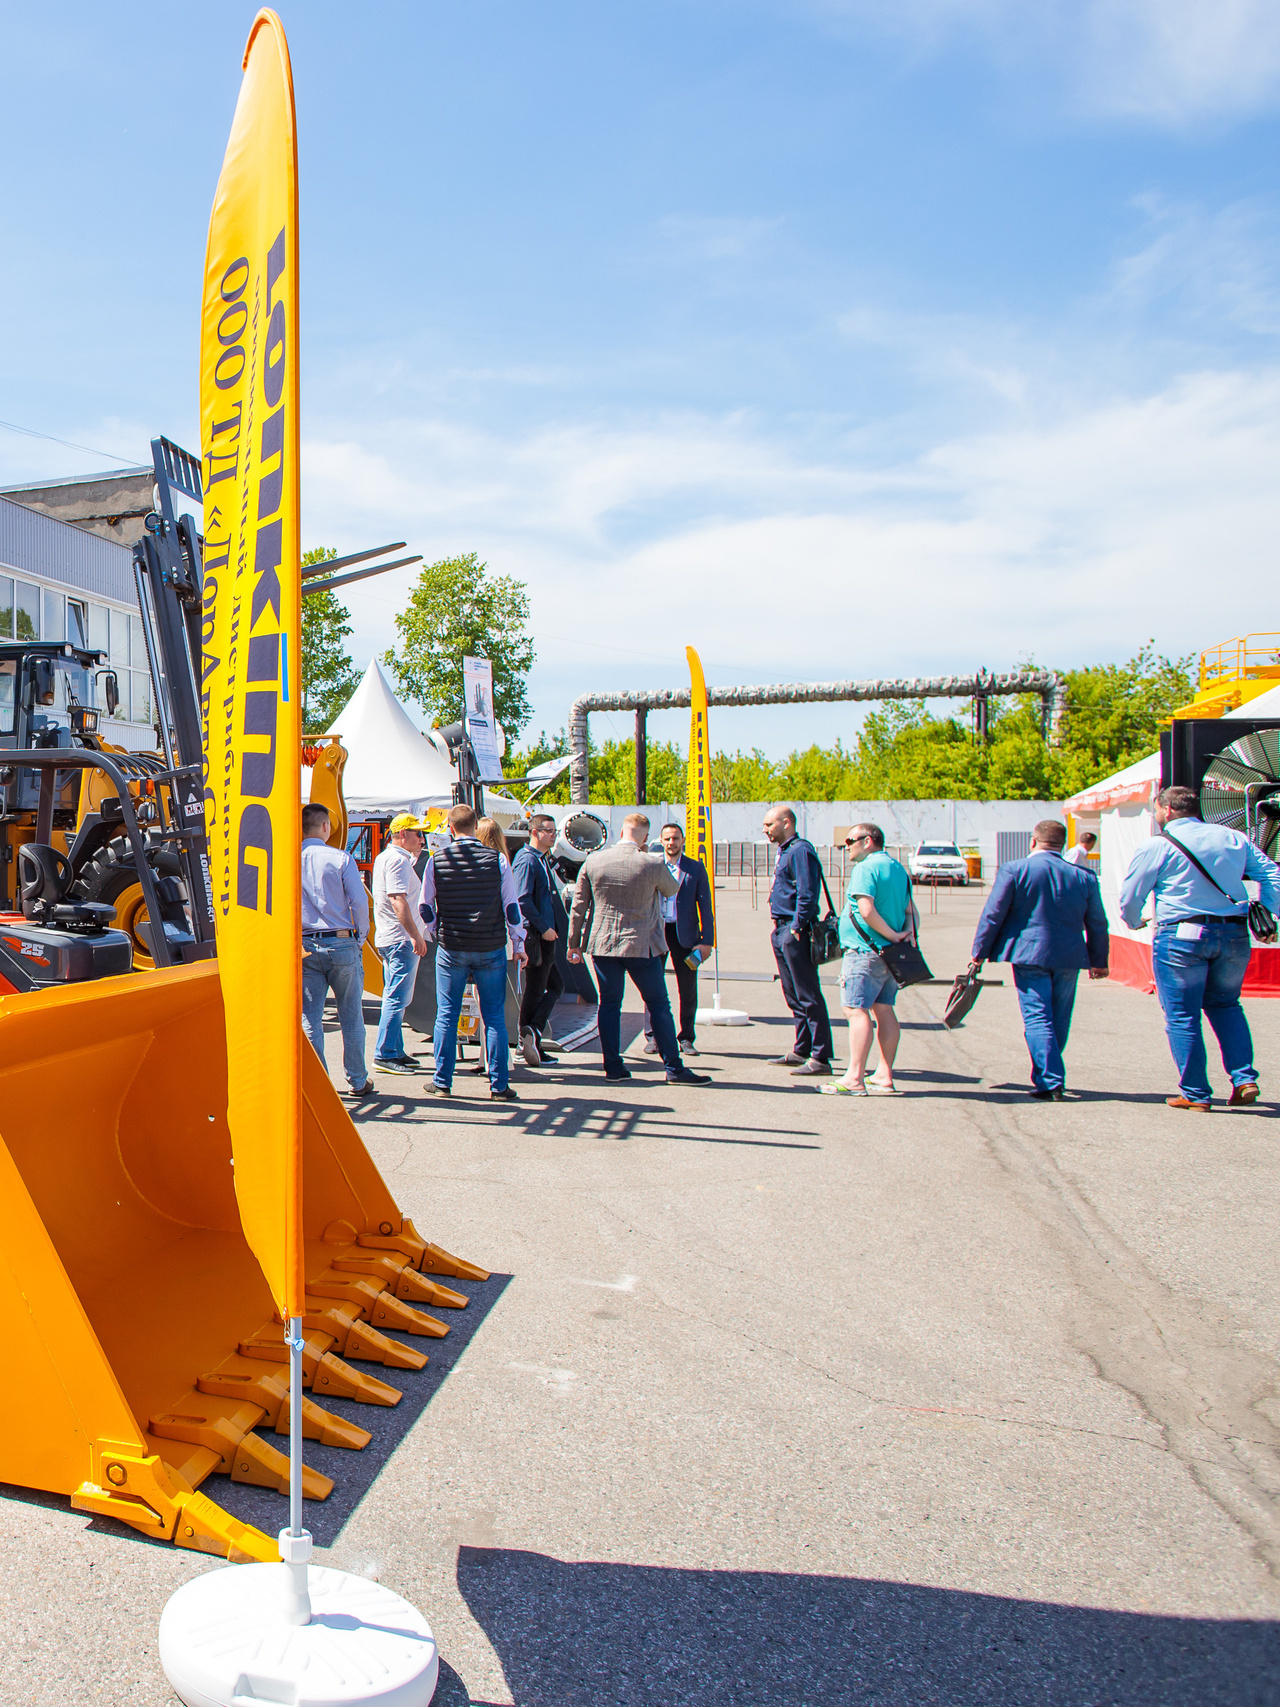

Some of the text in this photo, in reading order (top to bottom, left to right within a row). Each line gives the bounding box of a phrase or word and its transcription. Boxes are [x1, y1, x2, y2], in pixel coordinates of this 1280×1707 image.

[214, 256, 249, 390] ООО
[204, 400, 242, 496] ТД
[220, 595, 241, 916] дистрибьютор
[20, 941, 45, 957] 25
